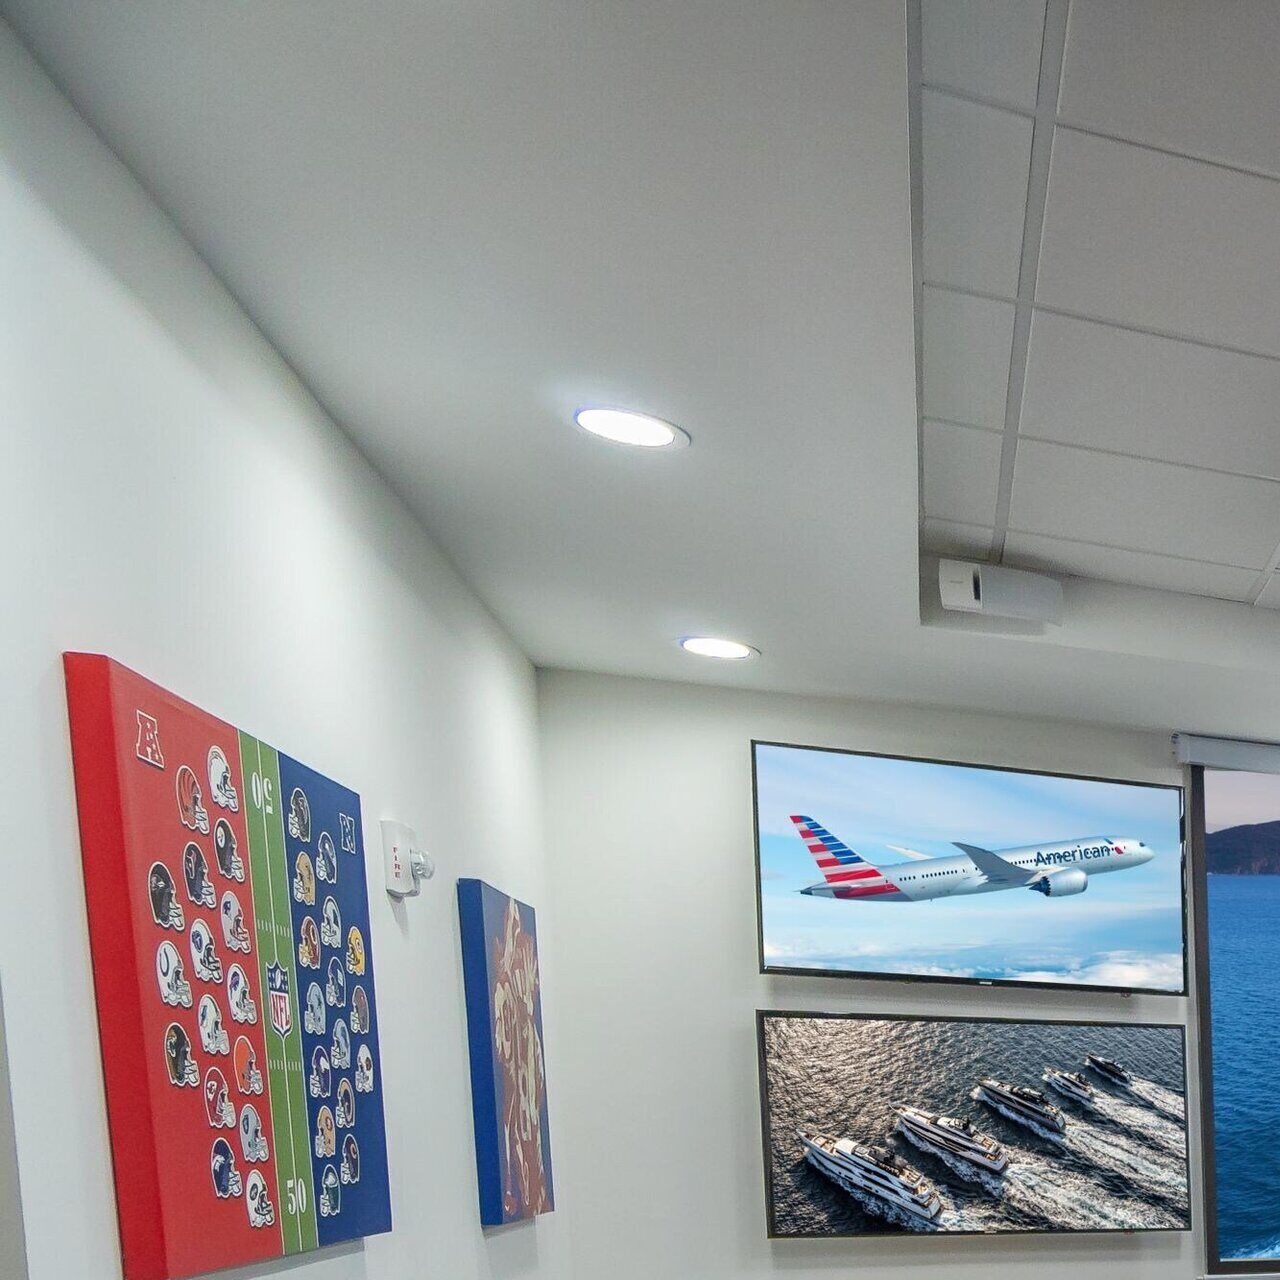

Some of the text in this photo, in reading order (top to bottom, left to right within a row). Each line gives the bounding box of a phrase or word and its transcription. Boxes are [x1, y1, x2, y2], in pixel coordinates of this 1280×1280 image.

[392, 846, 401, 878] FIRE
[1035, 844, 1110, 866] American
[286, 1177, 307, 1215] 50
